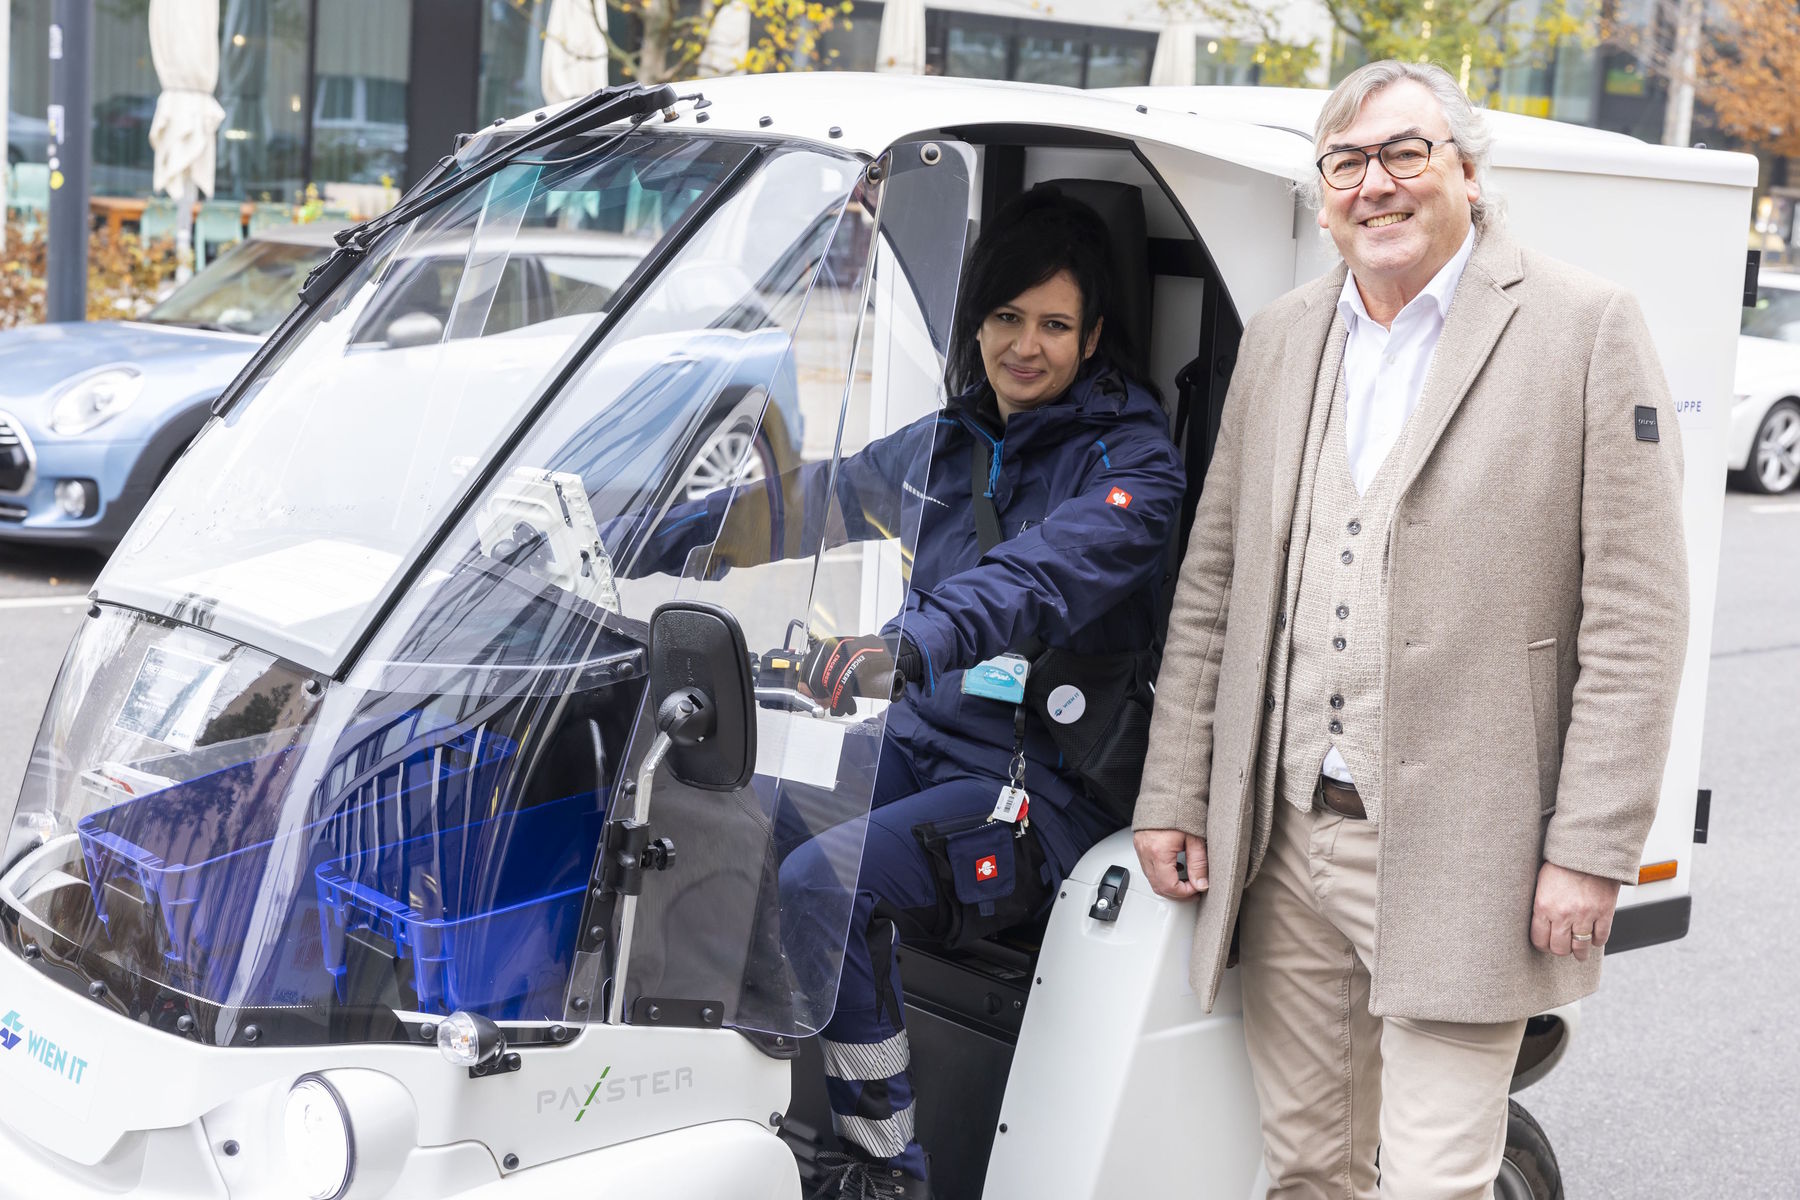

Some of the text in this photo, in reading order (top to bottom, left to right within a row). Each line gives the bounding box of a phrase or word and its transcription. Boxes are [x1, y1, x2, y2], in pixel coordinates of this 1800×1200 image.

[1674, 400, 1702, 412] UPPE
[841, 655, 866, 685] ENGELBERT
[28, 1029, 88, 1084] WIEN IT
[536, 1065, 693, 1122] PAXSTER
